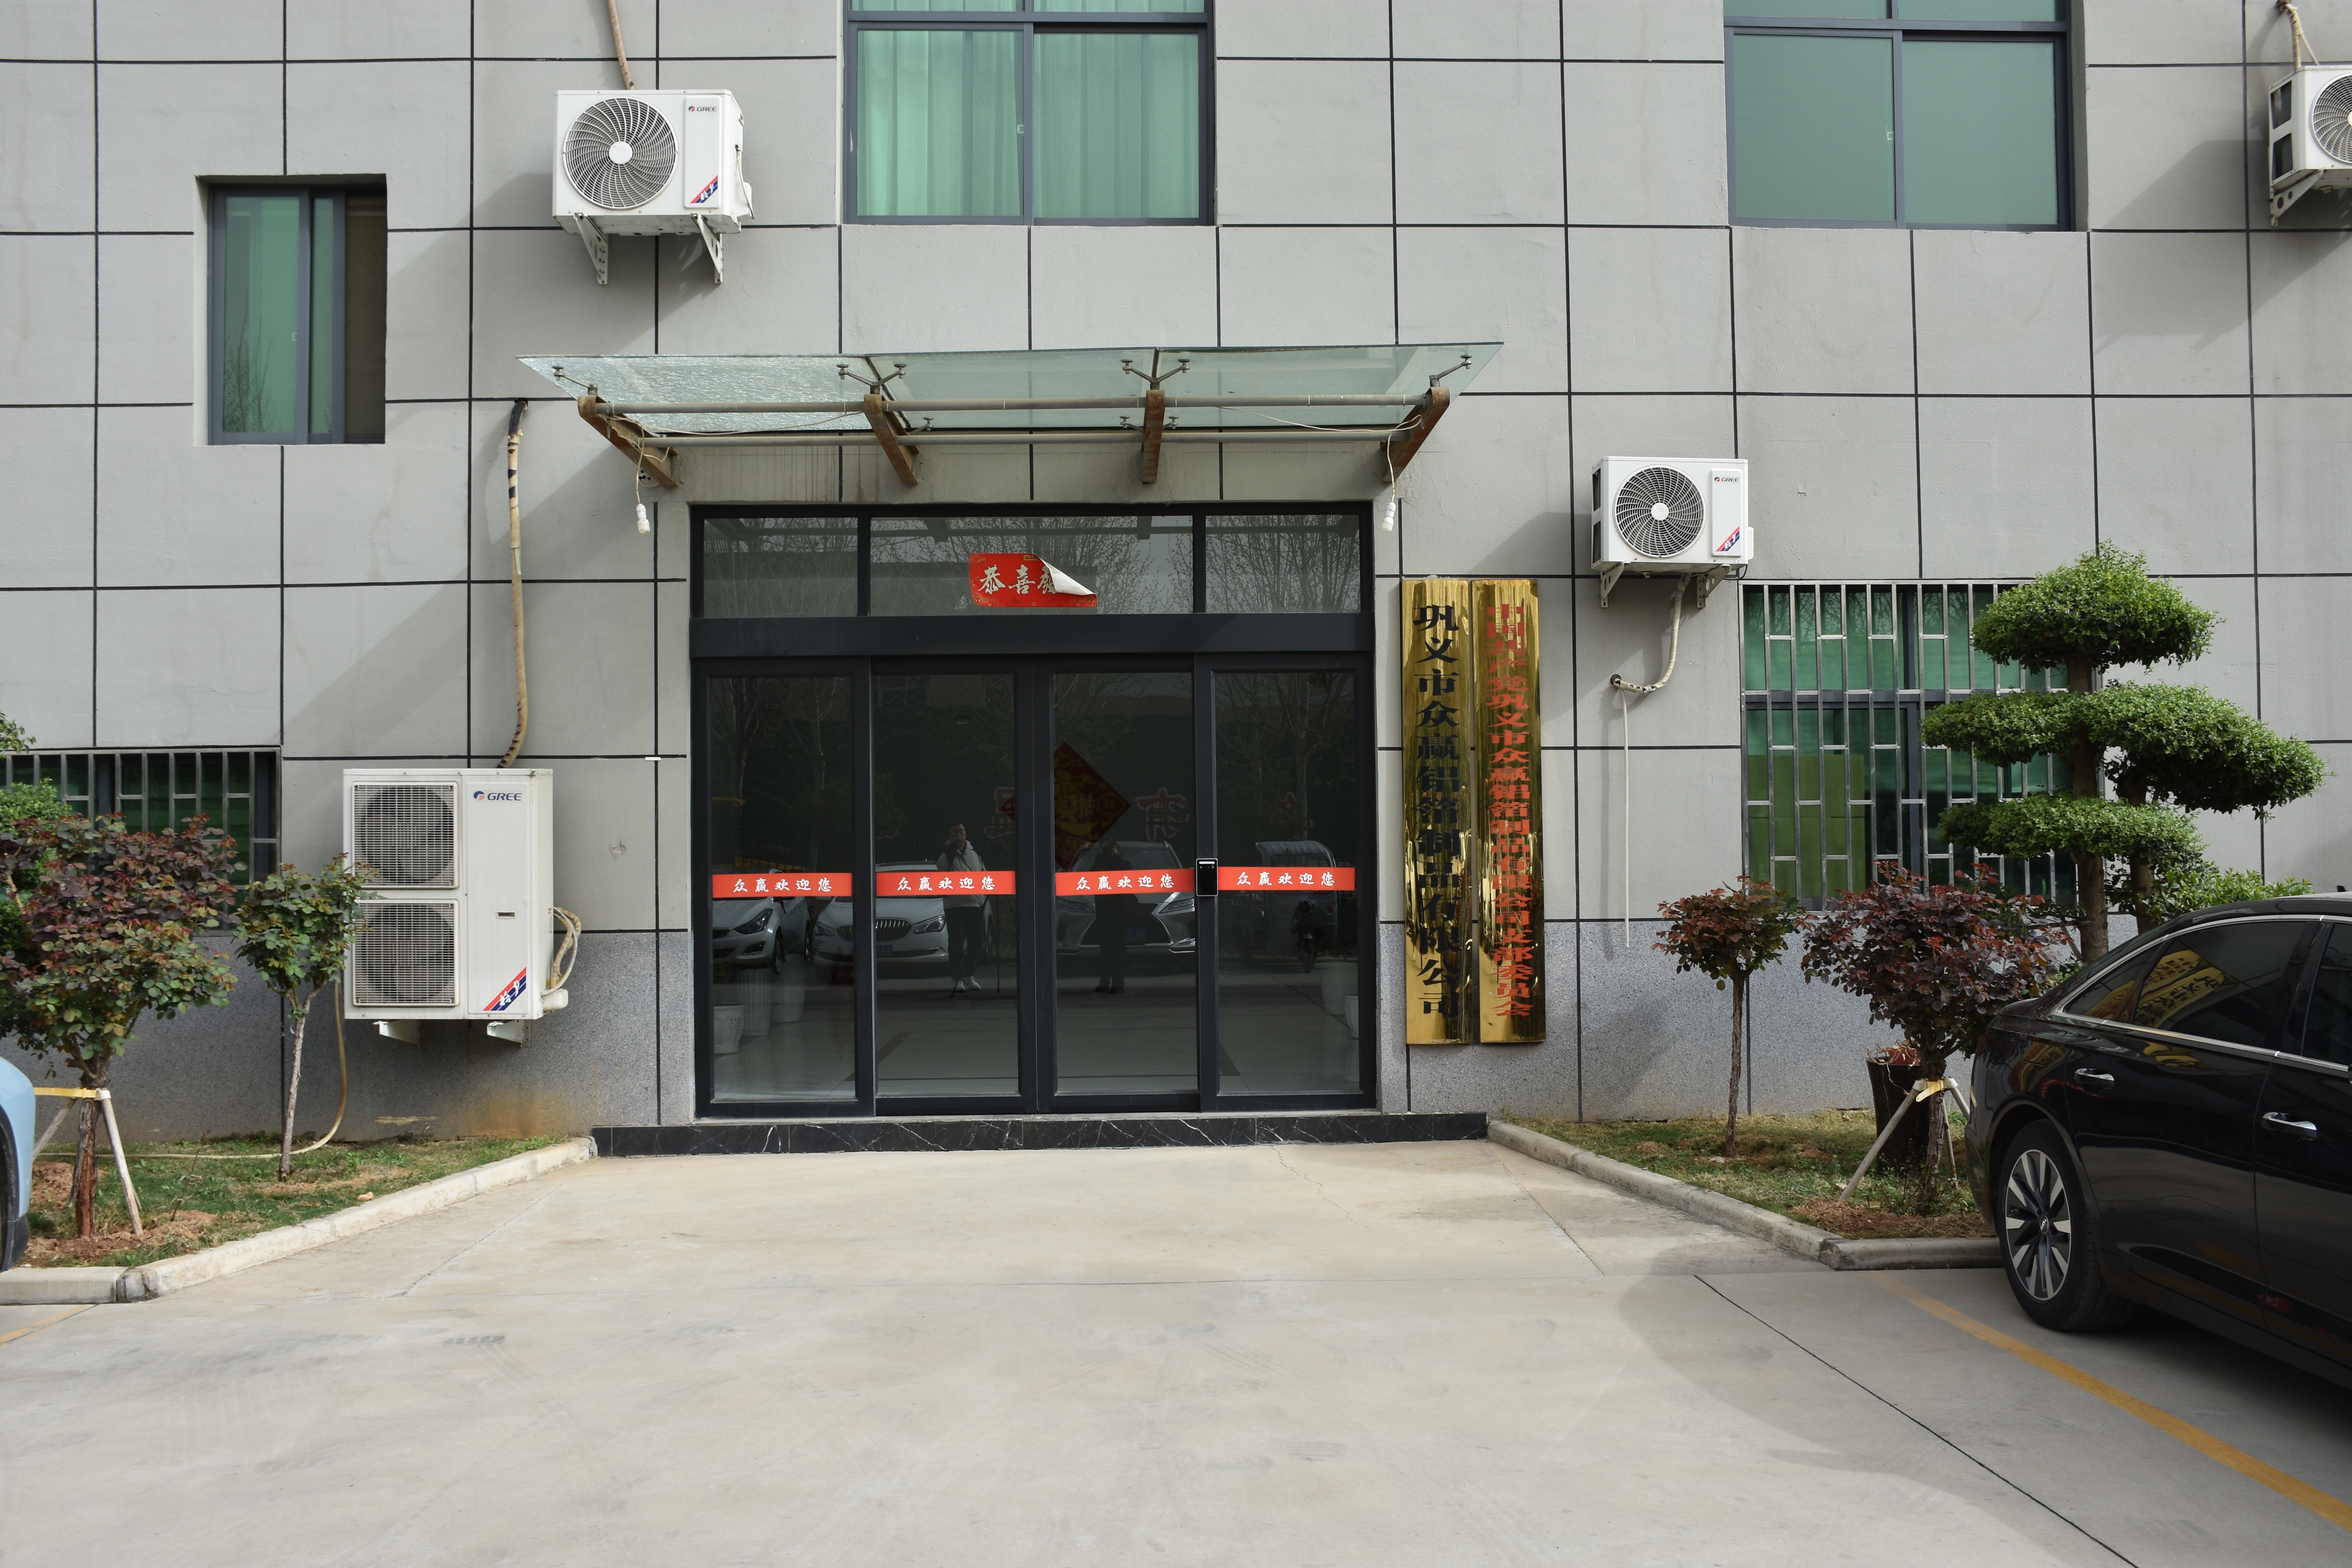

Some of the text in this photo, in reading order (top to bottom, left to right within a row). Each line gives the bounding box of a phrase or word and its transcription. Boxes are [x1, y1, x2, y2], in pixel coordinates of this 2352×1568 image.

[1412, 604, 1462, 1018] 巩义市众赢铝箔制品有限公司
[1486, 604, 1534, 1017] 中国共产党巩义市众赢铝箔制品有限公司支部委员会
[733, 877, 832, 893] 众赢欢迎您
[897, 875, 996, 891] 众赢欢迎您
[1076, 873, 1175, 890] 众赢欢迎您
[1236, 871, 1335, 886] 众赢欢迎您
